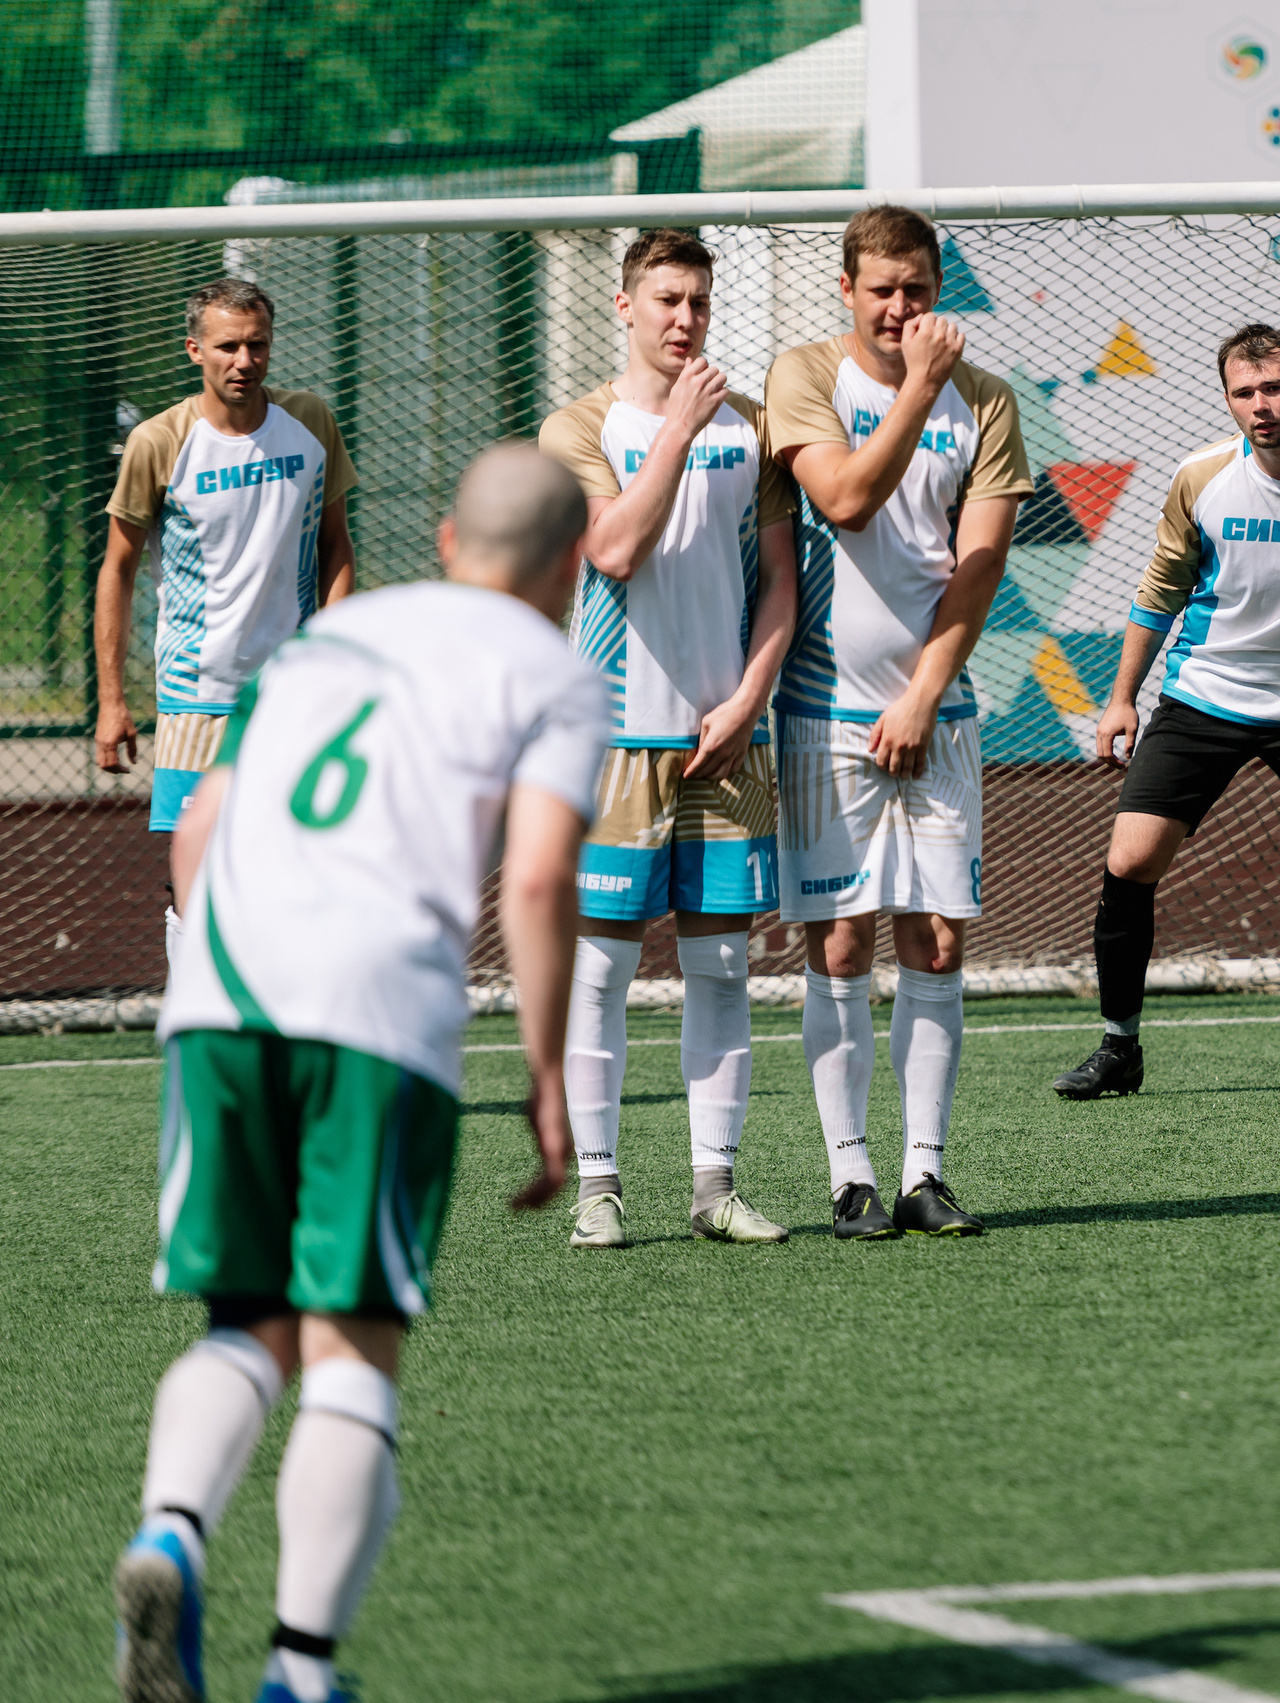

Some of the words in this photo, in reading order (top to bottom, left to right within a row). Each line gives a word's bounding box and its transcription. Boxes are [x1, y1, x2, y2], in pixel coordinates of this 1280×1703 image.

[625, 445, 745, 473] СУР
[196, 453, 304, 495] СИБУР
[289, 697, 378, 830] 6
[575, 872, 632, 893] ИБУР
[801, 869, 870, 895] СИБУР
